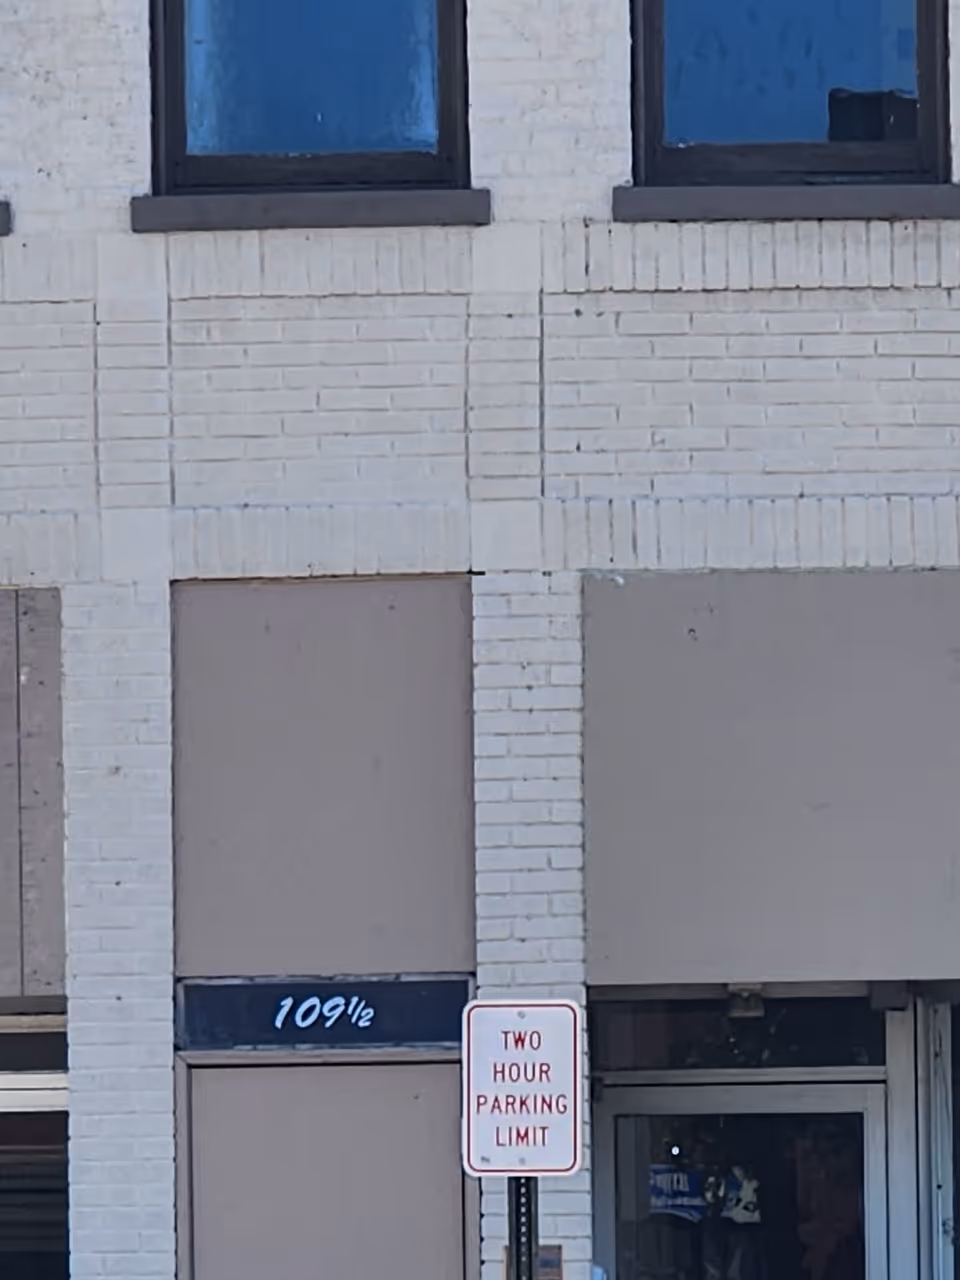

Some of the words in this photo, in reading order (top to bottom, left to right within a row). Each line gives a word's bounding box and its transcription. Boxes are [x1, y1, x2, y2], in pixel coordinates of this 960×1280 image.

[501, 1030, 542, 1051] TWO
[493, 1062, 551, 1083] HOUR
[476, 1094, 568, 1115] PARKING
[495, 1126, 549, 1147] LIMIT
